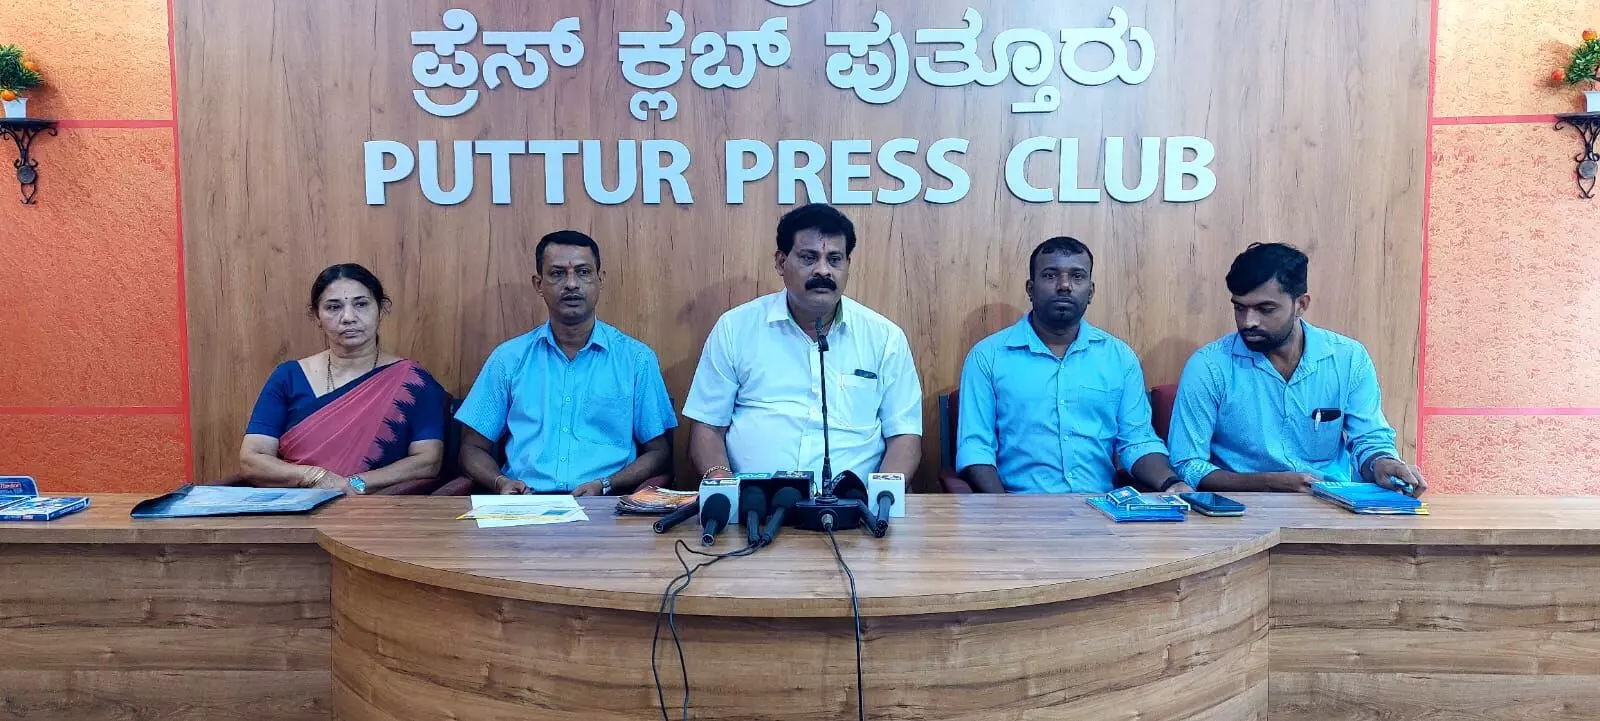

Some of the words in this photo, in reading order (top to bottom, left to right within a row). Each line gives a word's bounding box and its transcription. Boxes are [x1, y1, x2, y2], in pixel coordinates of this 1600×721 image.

[411, 8, 585, 117] ಪ್ರೆಸ್
[618, 10, 792, 121] ಕ್ಲಬ್
[825, 6, 1156, 114] ಪುತ್ತೂರು
[364, 139, 694, 205] PUTTUR
[725, 137, 971, 205] PRESS
[1004, 136, 1217, 203] CLUB
